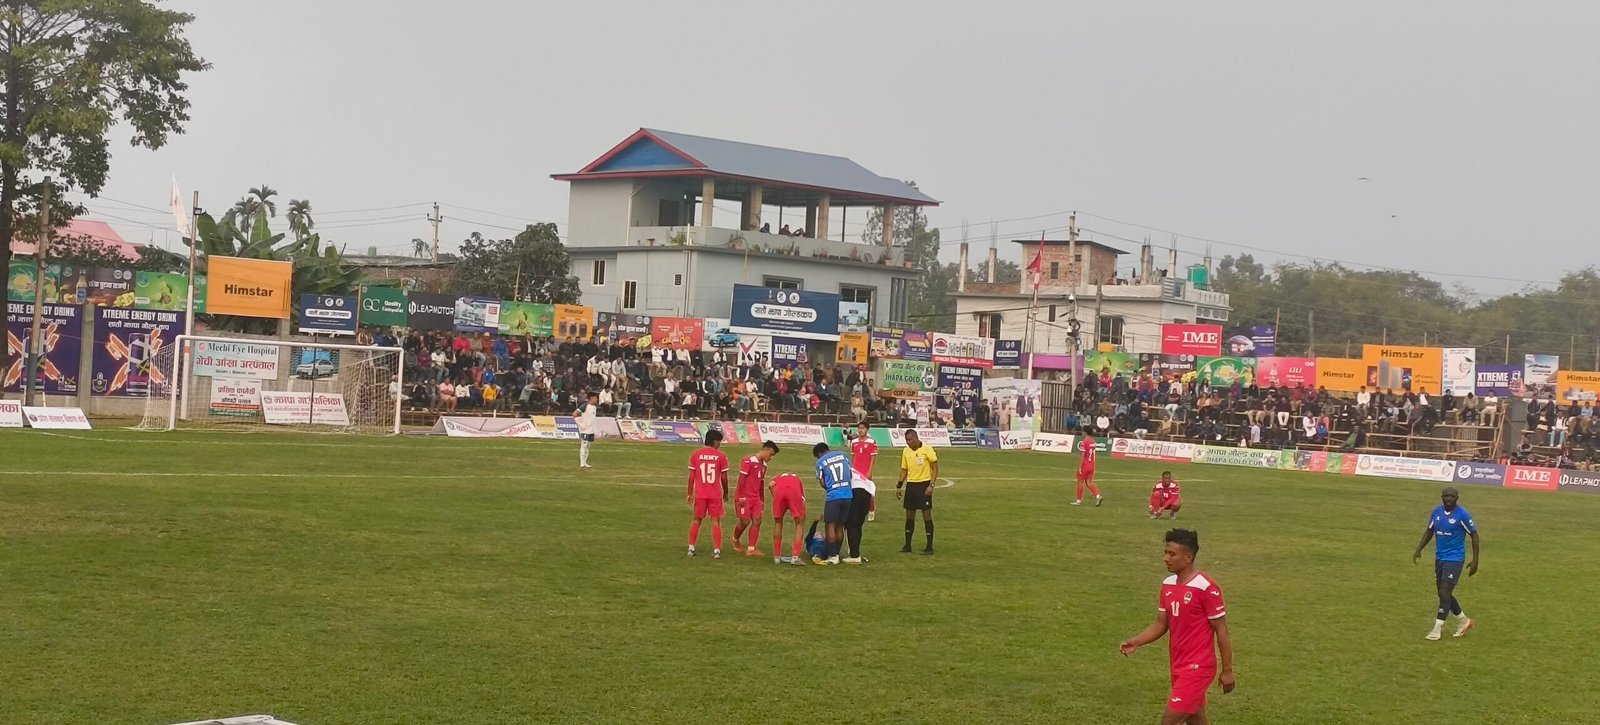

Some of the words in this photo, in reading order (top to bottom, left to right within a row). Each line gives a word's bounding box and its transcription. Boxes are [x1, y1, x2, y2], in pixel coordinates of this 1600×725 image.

[224, 284, 274, 299] Himstar
[363, 298, 380, 312] QC
[417, 305, 454, 315] LEAPMOTOR
[26, 305, 53, 318] ENGY
[54, 308, 75, 319] DRINK
[103, 309, 130, 320] XTREME
[131, 311, 156, 321] ENERGY
[157, 313, 177, 323] DRINK
[1182, 331, 1218, 344] IME
[208, 342, 230, 352] Mechi
[232, 345, 246, 355] Eye
[247, 345, 278, 356] Hospital
[774, 344, 798, 355] XTREME
[1381, 349, 1424, 359] Himstar
[197, 355, 212, 367] मेची
[240, 359, 276, 371] अस्पताल
[885, 373, 903, 382] JHAPA
[904, 375, 921, 384] GOLD
[1323, 371, 1355, 379] Himstar
[1477, 371, 1509, 382] XTREME
[274, 395, 296, 405] झापा
[1001, 433, 1018, 446] KDS
[1036, 439, 1053, 447] TVS
[1228, 458, 1250, 466] GOLD
[1251, 459, 1265, 467] CUP
[700, 462, 716, 484] 15
[829, 462, 844, 482] 17
[1513, 469, 1552, 482] IME
